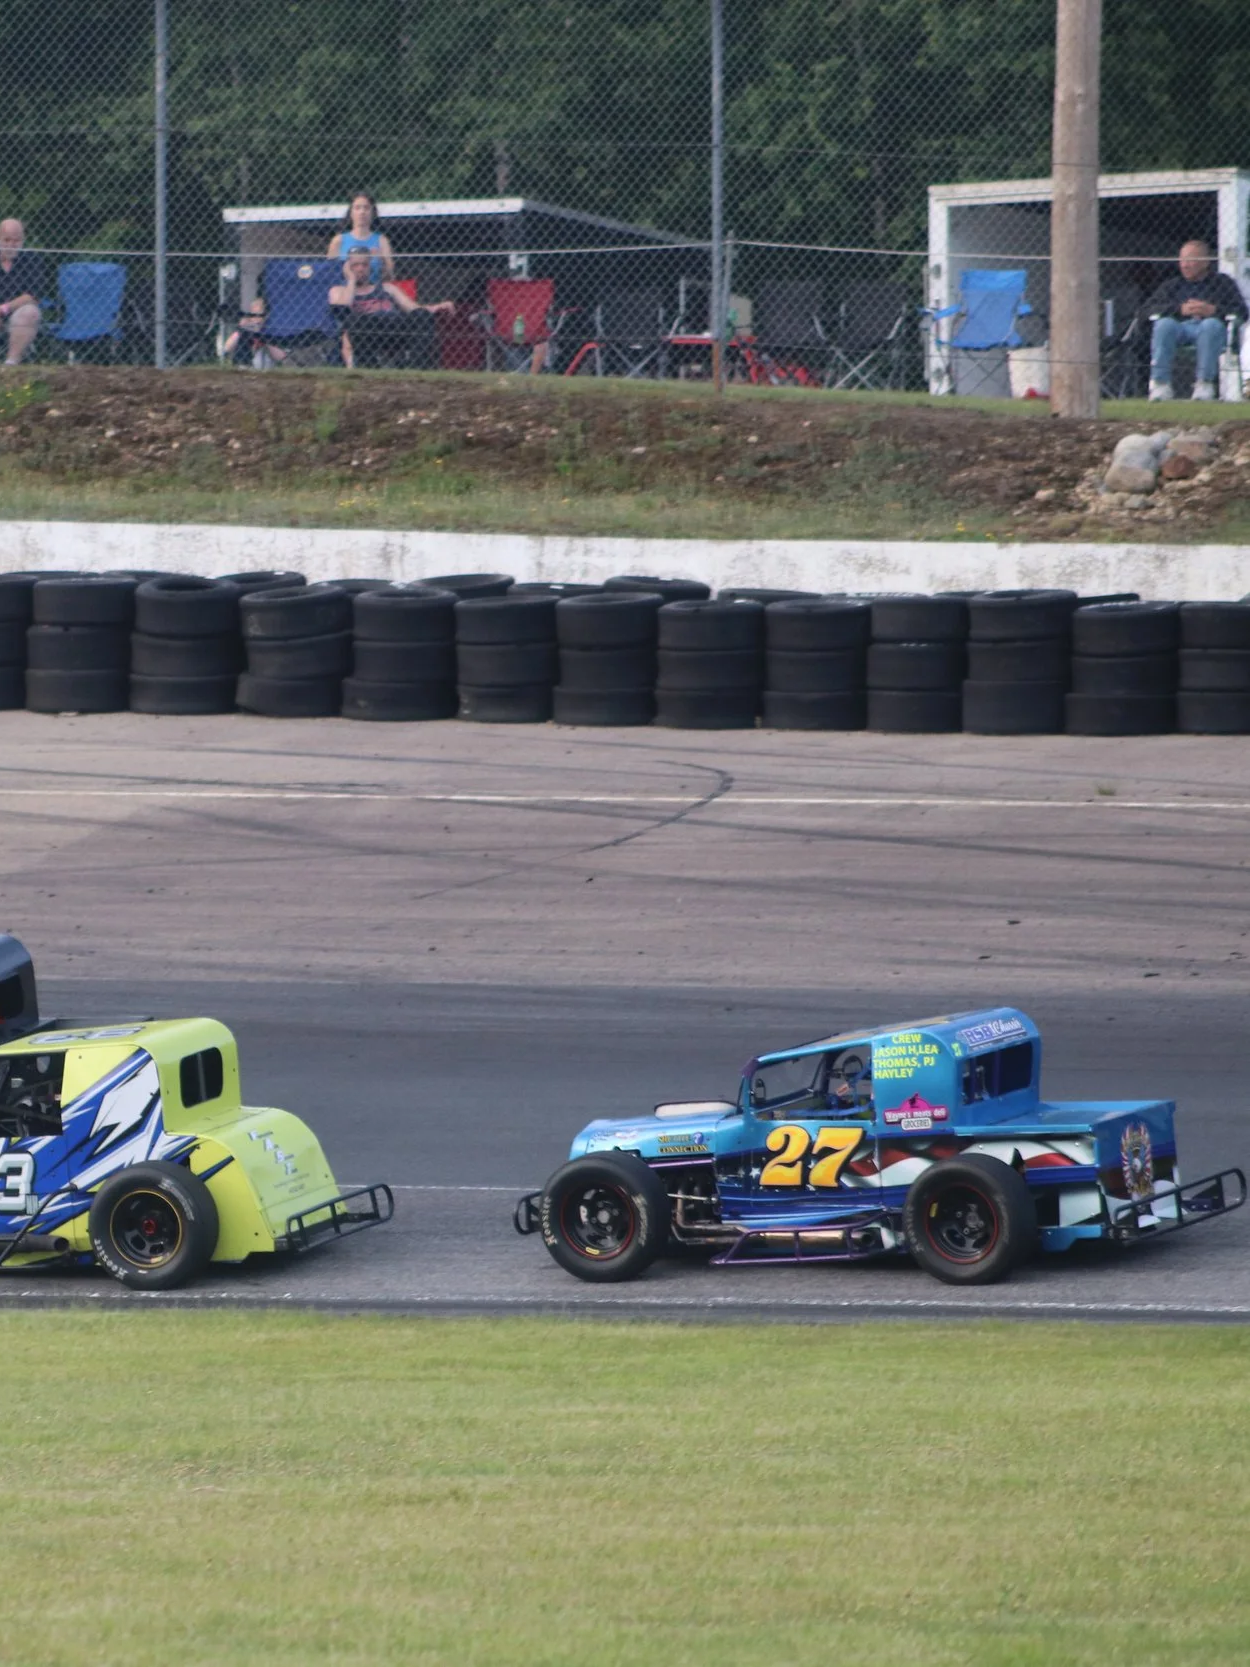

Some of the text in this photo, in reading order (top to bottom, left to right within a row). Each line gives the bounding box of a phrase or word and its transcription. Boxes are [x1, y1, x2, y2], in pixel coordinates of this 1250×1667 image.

[892, 1033, 922, 1044] CREW
[873, 1046, 906, 1058] JASON
[873, 1056, 935, 1068] THOMAS, PJ
[874, 1068, 914, 1079] HAYLEY
[884, 1111, 911, 1122] Wayne's
[759, 1125, 867, 1189] 27
